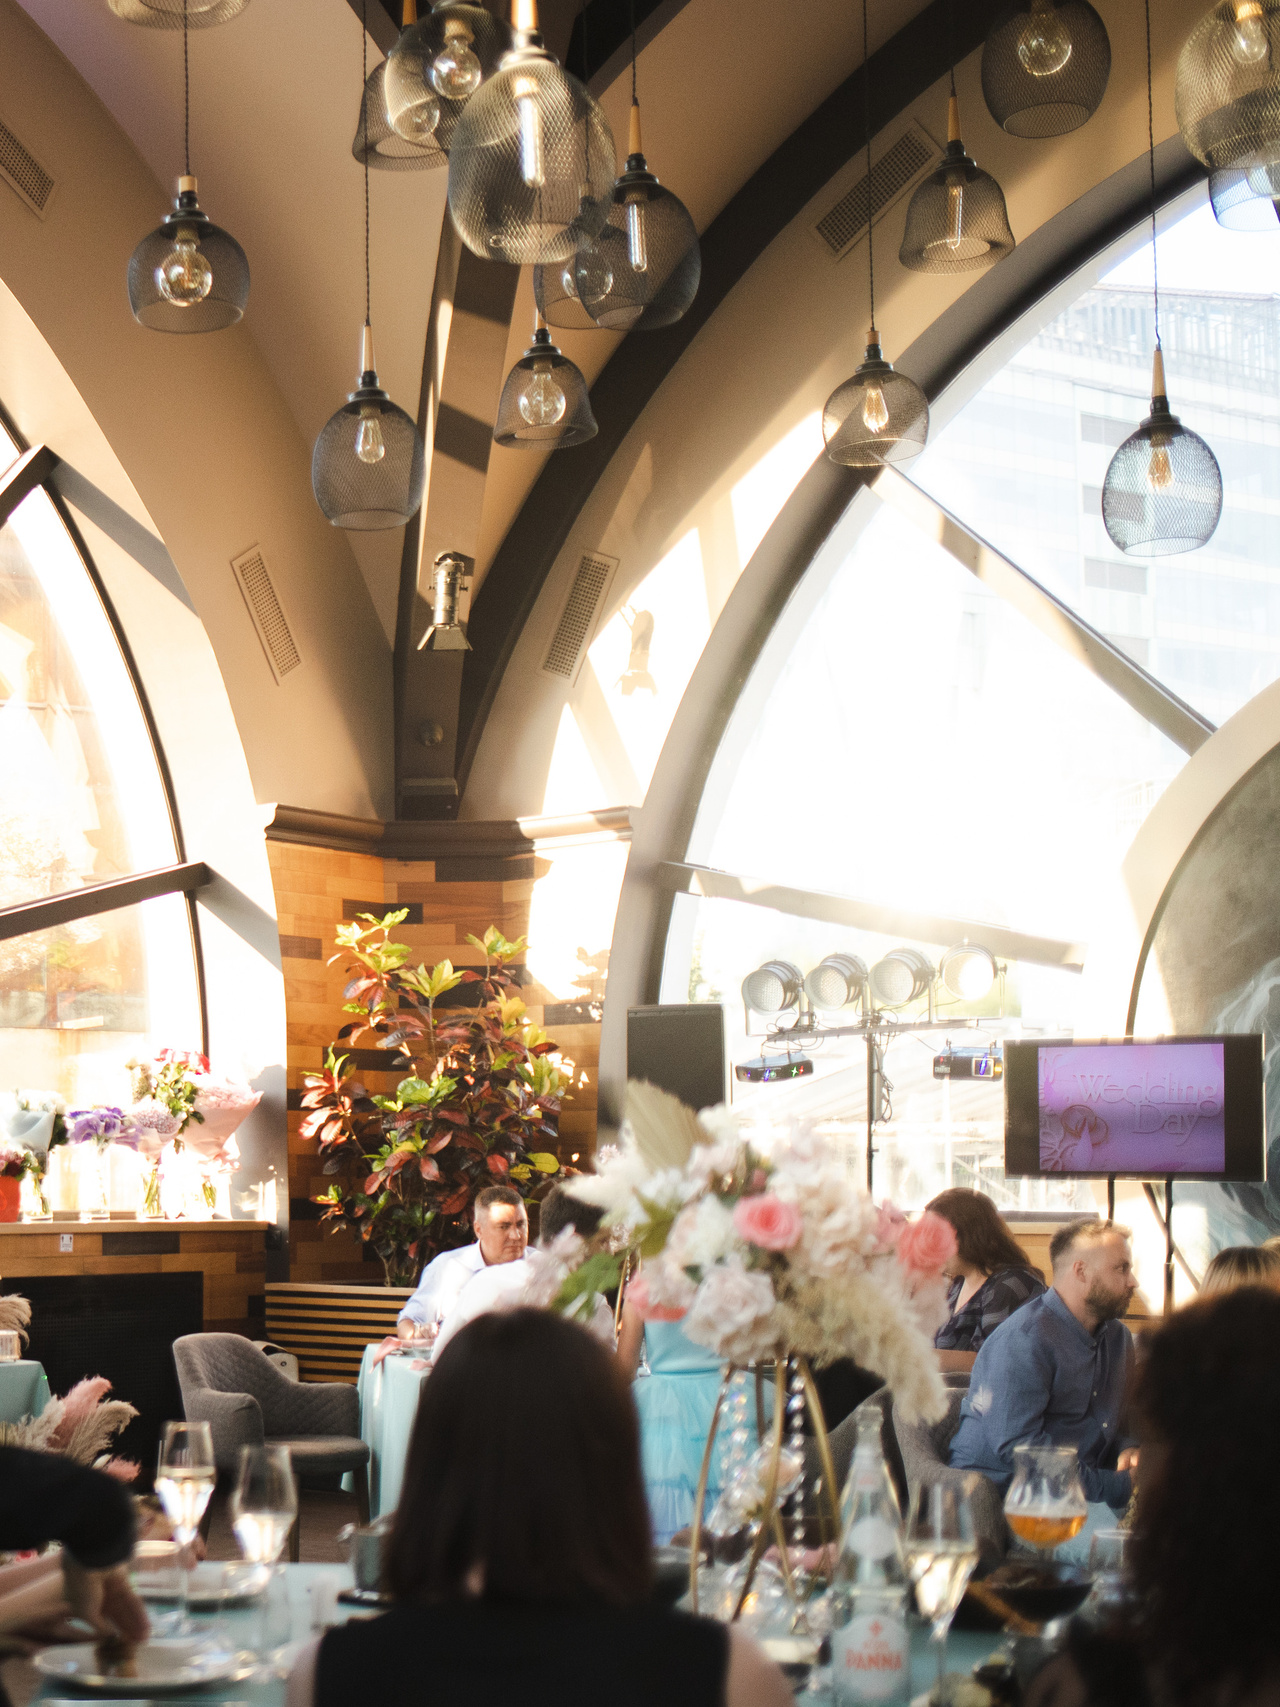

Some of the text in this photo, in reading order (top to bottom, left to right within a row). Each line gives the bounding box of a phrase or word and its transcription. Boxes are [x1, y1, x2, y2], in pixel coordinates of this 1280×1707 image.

[1072, 1071, 1223, 1118] Wedding
[1131, 1104, 1200, 1147] Day
[845, 1648, 902, 1671] PANNA
